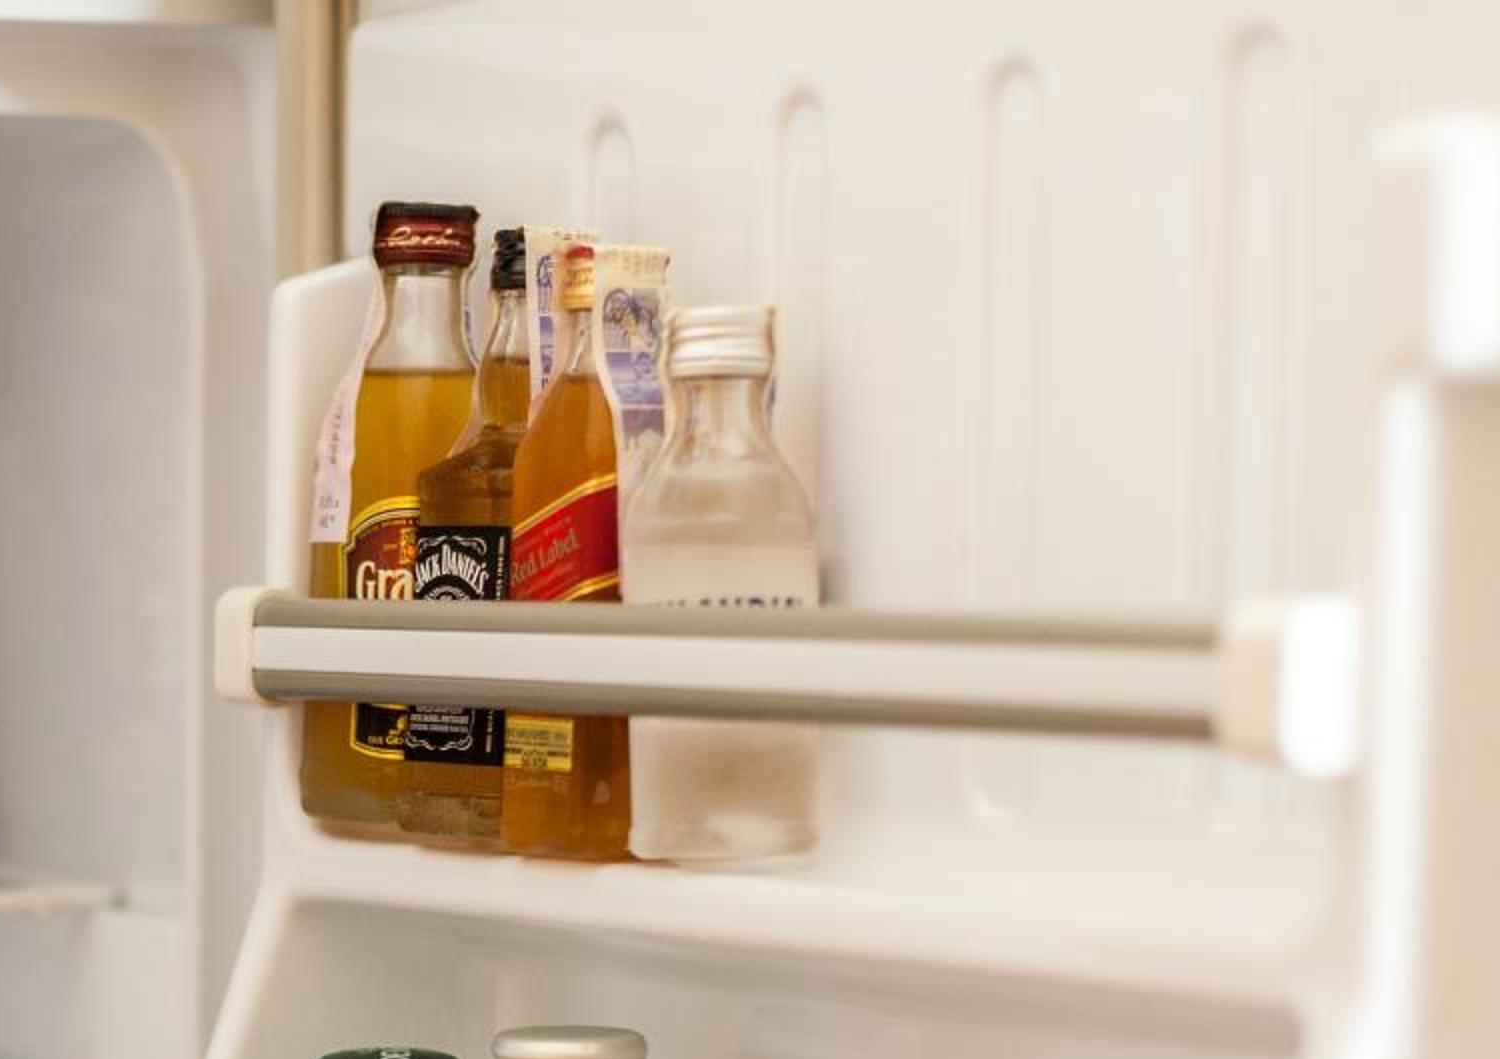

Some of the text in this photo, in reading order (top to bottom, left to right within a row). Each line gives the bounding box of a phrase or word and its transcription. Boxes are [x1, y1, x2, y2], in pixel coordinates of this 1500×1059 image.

[415, 553, 441, 594] JACK
[510, 549, 536, 588] Red
[538, 527, 580, 569] Label
